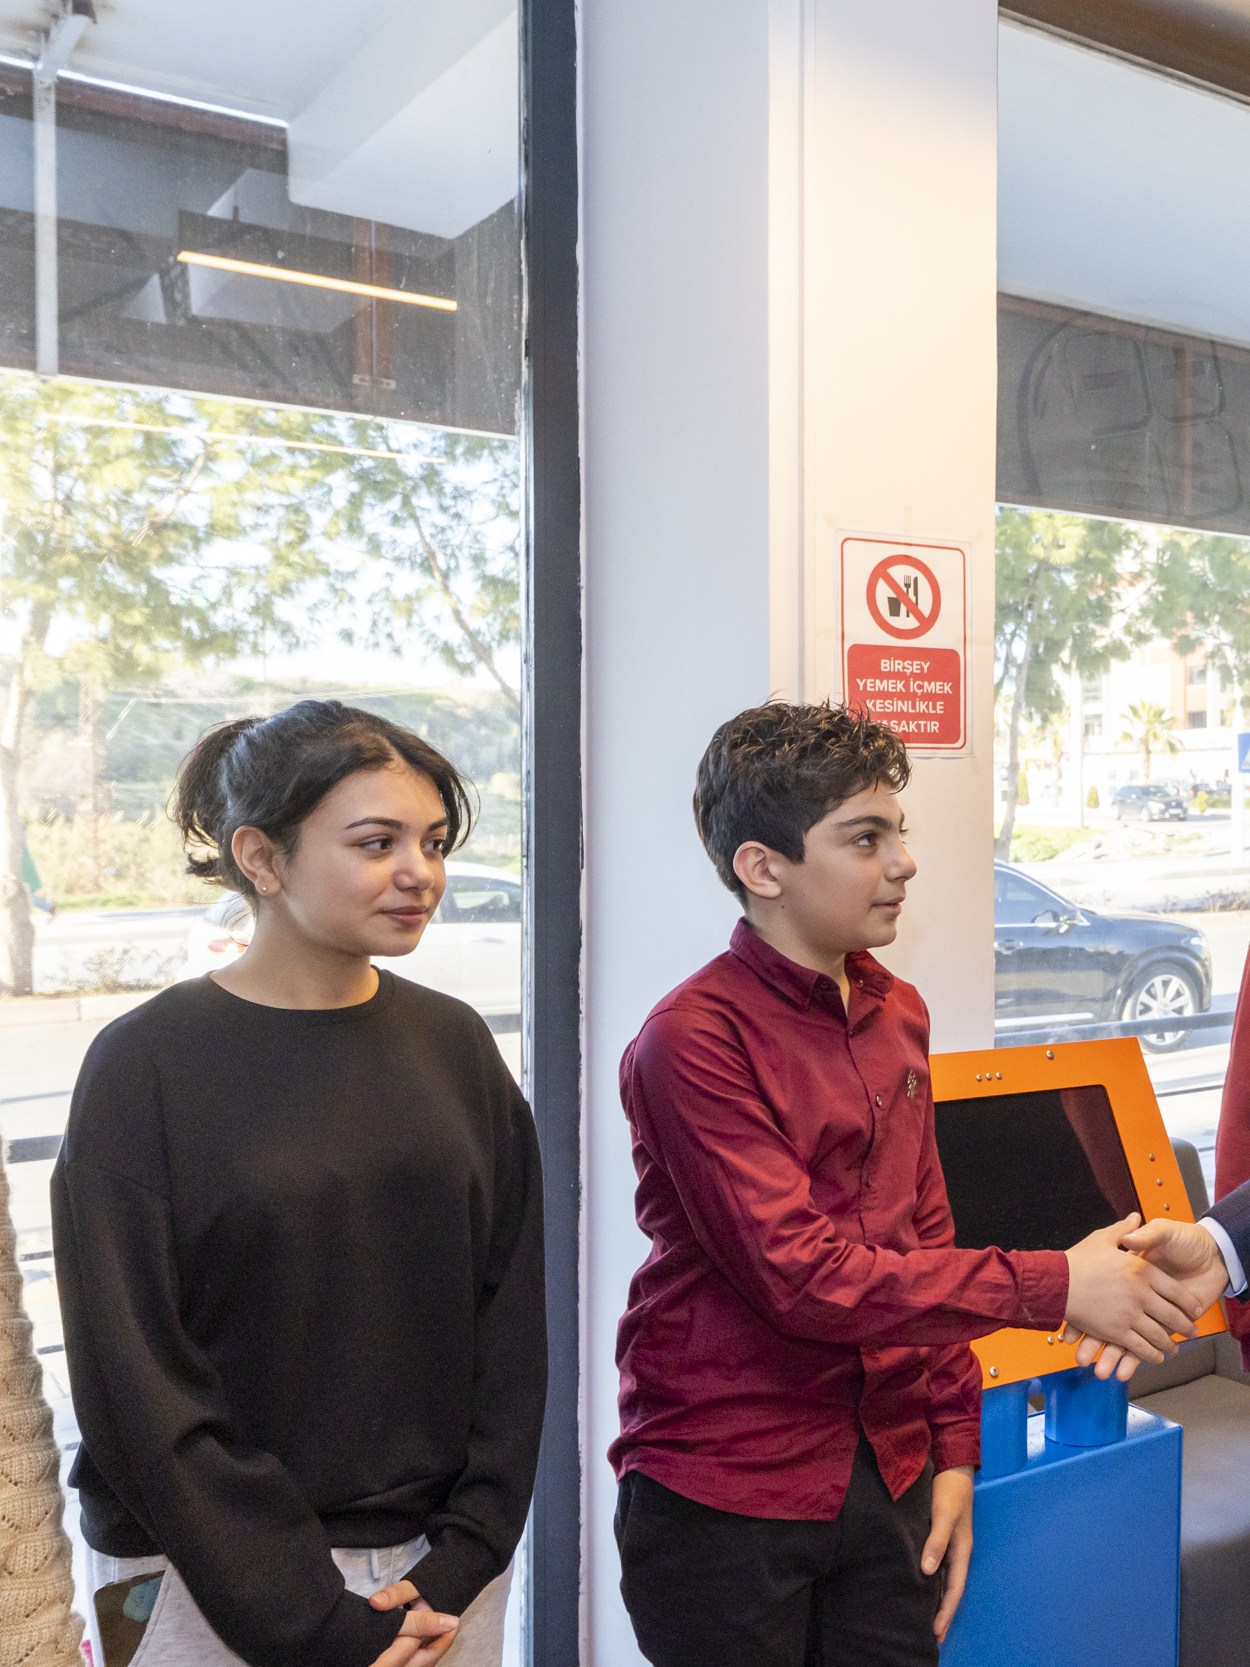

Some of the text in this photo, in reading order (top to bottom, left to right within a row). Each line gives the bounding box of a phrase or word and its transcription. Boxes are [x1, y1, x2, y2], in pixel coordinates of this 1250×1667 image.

[880, 657, 931, 676] BİRŞEY
[856, 678, 953, 696] YEMEK İÇMEK
[866, 697, 945, 714] KESİNLİKLE
[871, 719, 940, 733] SAKTIR
